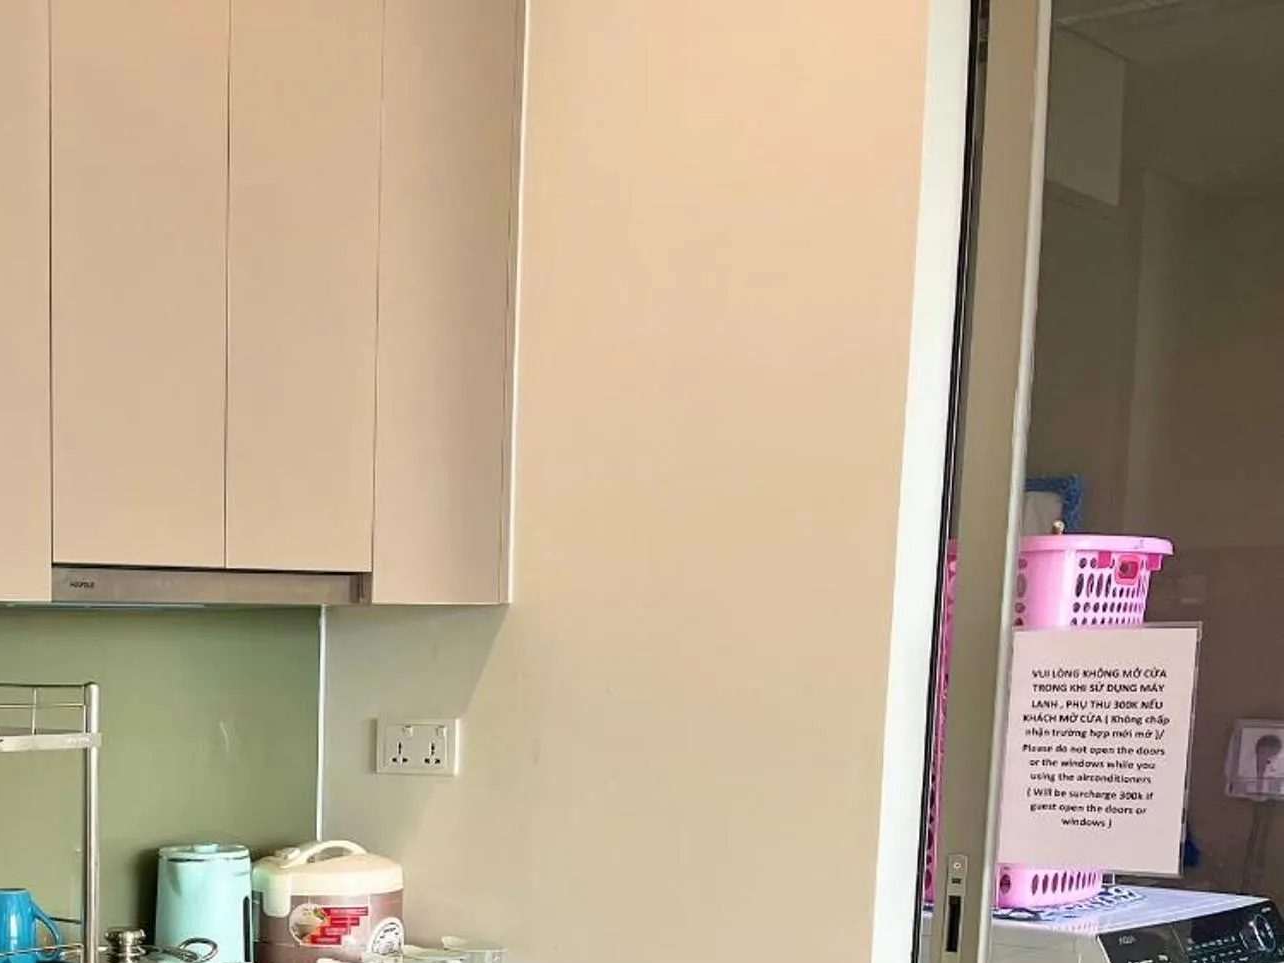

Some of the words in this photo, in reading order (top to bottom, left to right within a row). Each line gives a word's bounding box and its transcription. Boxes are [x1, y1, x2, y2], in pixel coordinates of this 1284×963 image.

[1032, 670, 1050, 678] VUI
[1033, 684, 1067, 692] TRONG
[1070, 684, 1087, 692] KHI
[1090, 700, 1111, 709] THU
[1113, 700, 1139, 709] 300K
[1022, 744, 1053, 752] Please
[1056, 744, 1067, 752] do
[1090, 747, 1114, 755] open
[1117, 746, 1134, 754] the
[1136, 747, 1165, 755] doors
[1061, 759, 1104, 767] windows
[1136, 762, 1156, 770] you
[1030, 772, 1055, 782] using
[1058, 772, 1074, 781] the
[1077, 773, 1151, 783] airconditioners
[1033, 788, 1053, 796] Will
[1054, 789, 1067, 797] be
[1069, 790, 1117, 800] surcharge
[1030, 803, 1057, 812] guest
[1059, 804, 1084, 812] open
[1086, 804, 1103, 813] the
[1105, 805, 1133, 814] doors
[1135, 807, 1147, 815] or
[1061, 818, 1105, 827] windows
